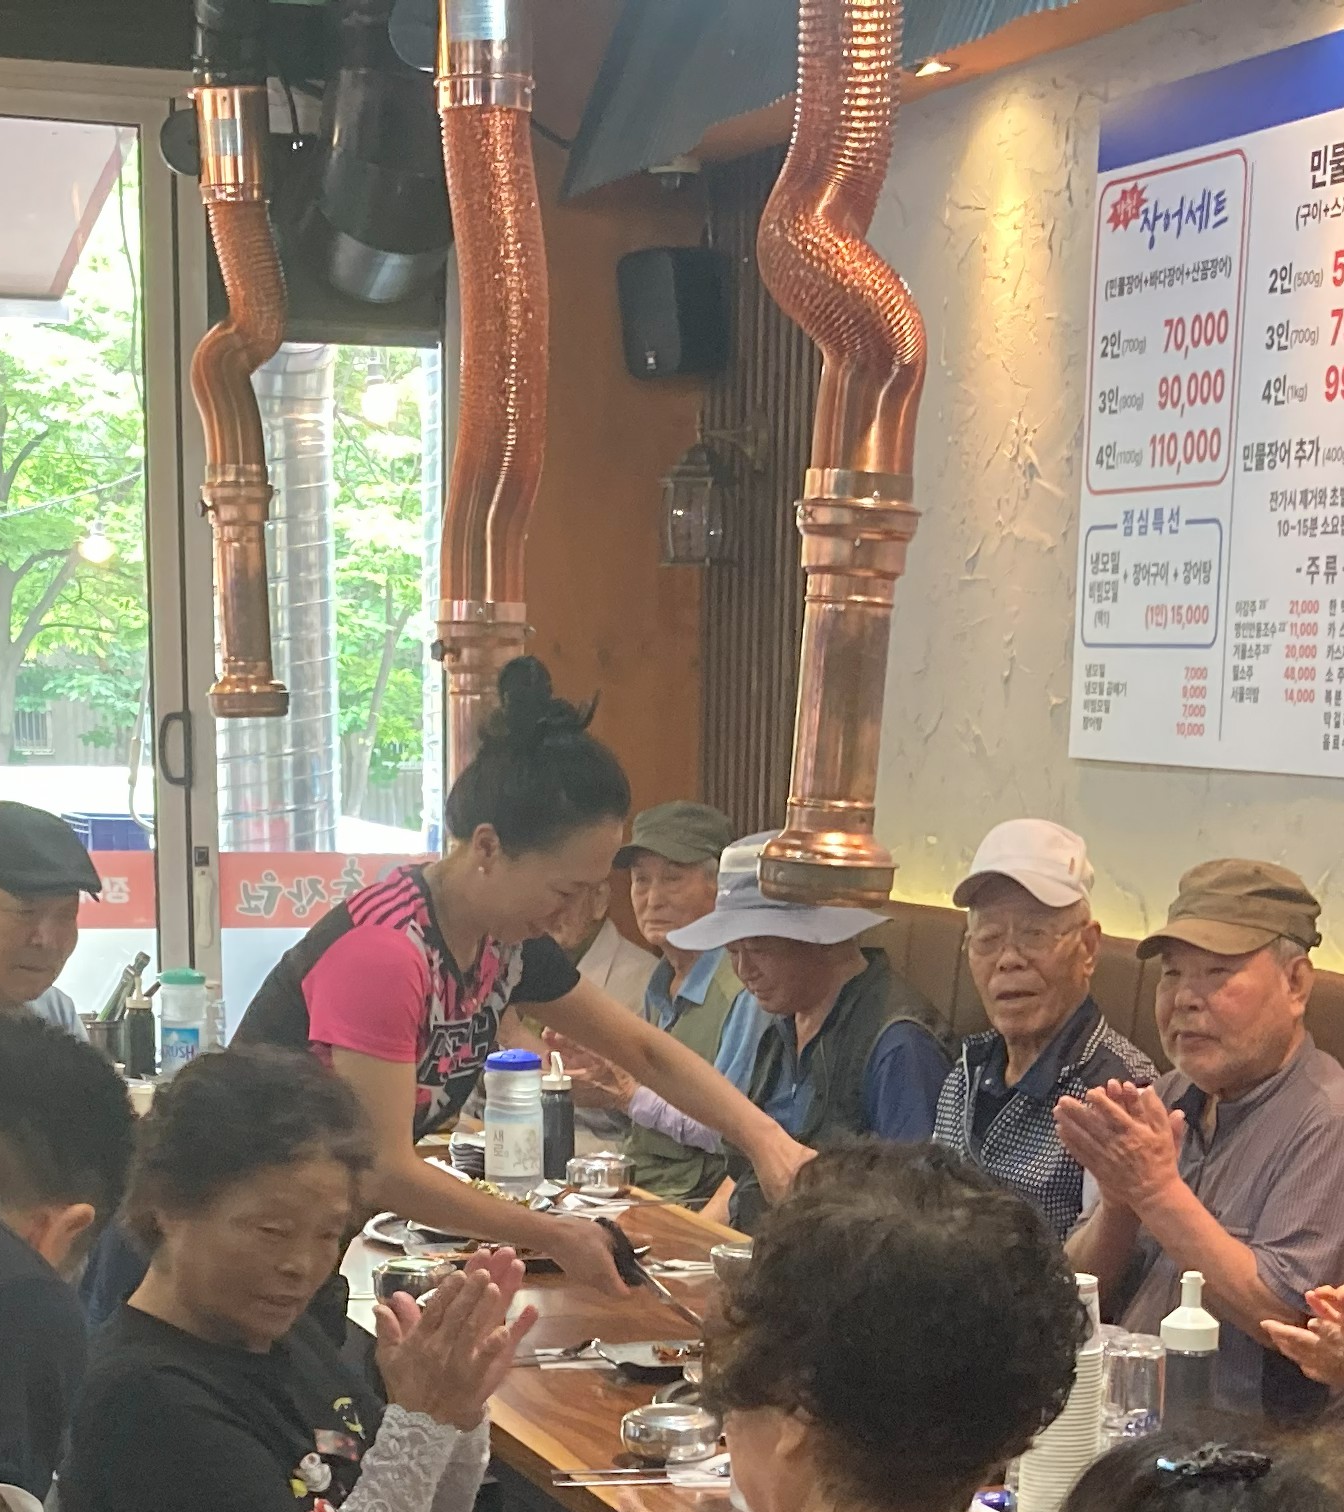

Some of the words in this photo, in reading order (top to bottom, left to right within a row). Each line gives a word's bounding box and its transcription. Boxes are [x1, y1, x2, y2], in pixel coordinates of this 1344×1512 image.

[1140, 188, 1228, 250] 장어세트
[1163, 309, 1228, 360] 70,000
[1158, 368, 1225, 418] 90,000
[1150, 427, 1221, 475] 110,000
[1242, 439, 1291, 472] 민물장어
[1294, 435, 1320, 468] 추가
[1171, 604, 1209, 629] 15,000
[1289, 600, 1319, 617] 21,000
